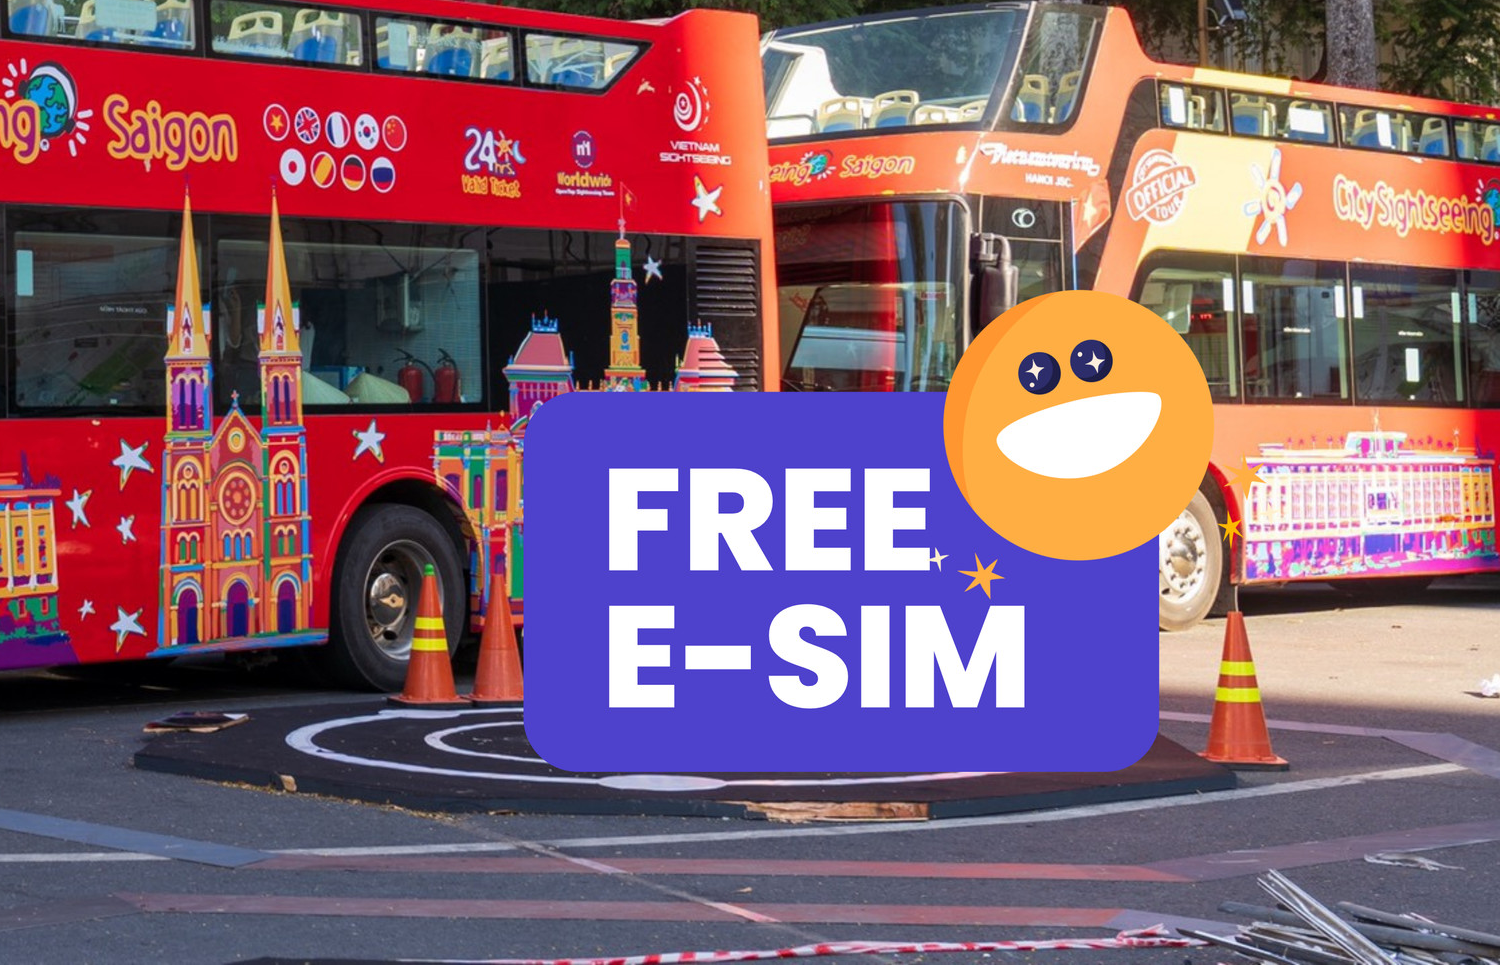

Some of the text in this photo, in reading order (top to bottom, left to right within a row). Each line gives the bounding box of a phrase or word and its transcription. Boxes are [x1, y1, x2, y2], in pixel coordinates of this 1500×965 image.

[103, 93, 239, 171] Saigon
[464, 126, 497, 172] 24
[670, 140, 720, 153] VIETNAM
[556, 171, 612, 188] Worldwide
[839, 154, 915, 179] Saigon
[1133, 168, 1193, 211] OFFICIAL
